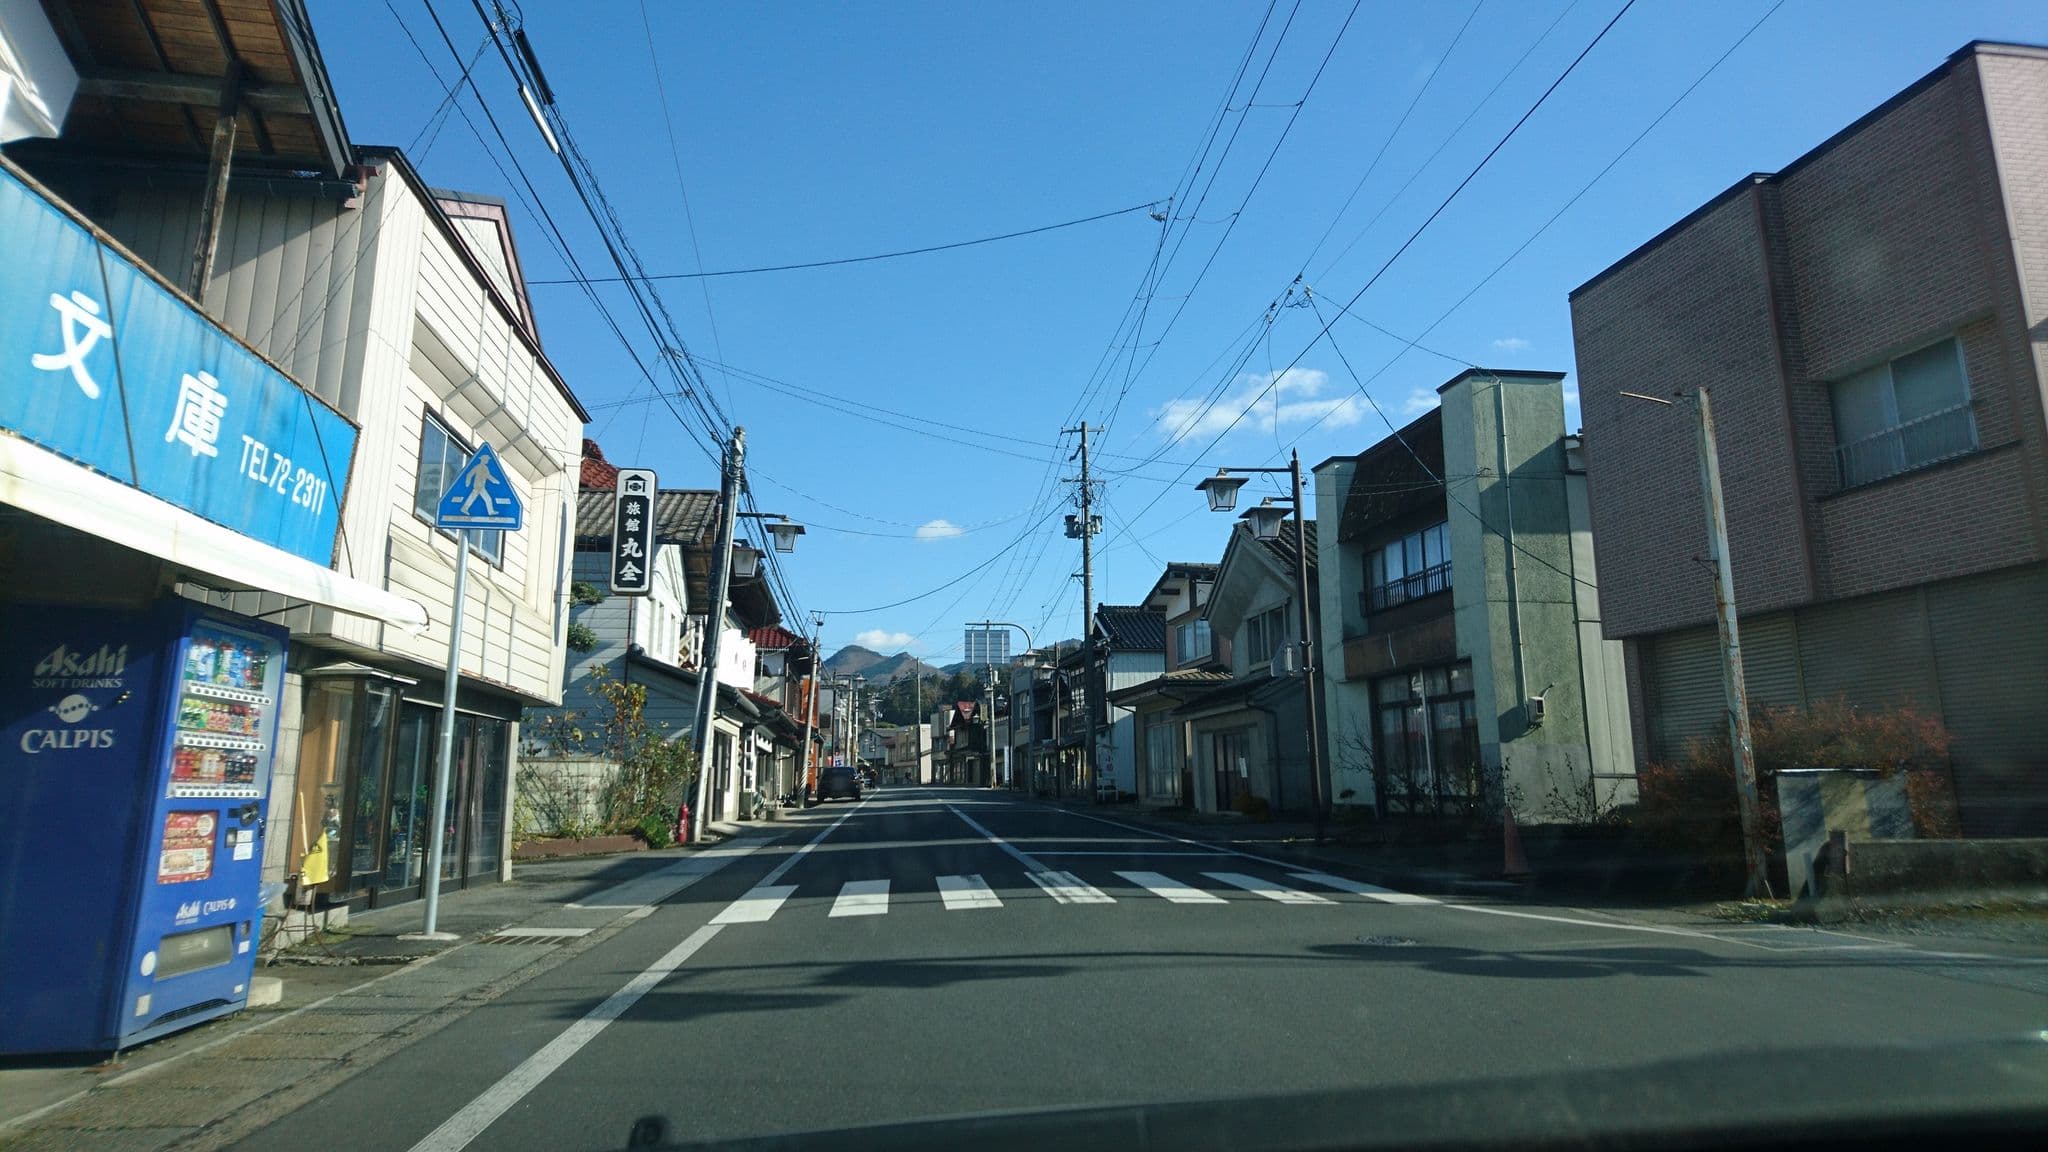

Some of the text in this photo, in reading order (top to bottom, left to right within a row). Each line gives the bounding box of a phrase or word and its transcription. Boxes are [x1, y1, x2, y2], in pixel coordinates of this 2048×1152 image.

[34, 644, 128, 677] Asahi
[32, 678, 123, 689] SOFT DRINKS
[20, 729, 114, 754] CALPIS
